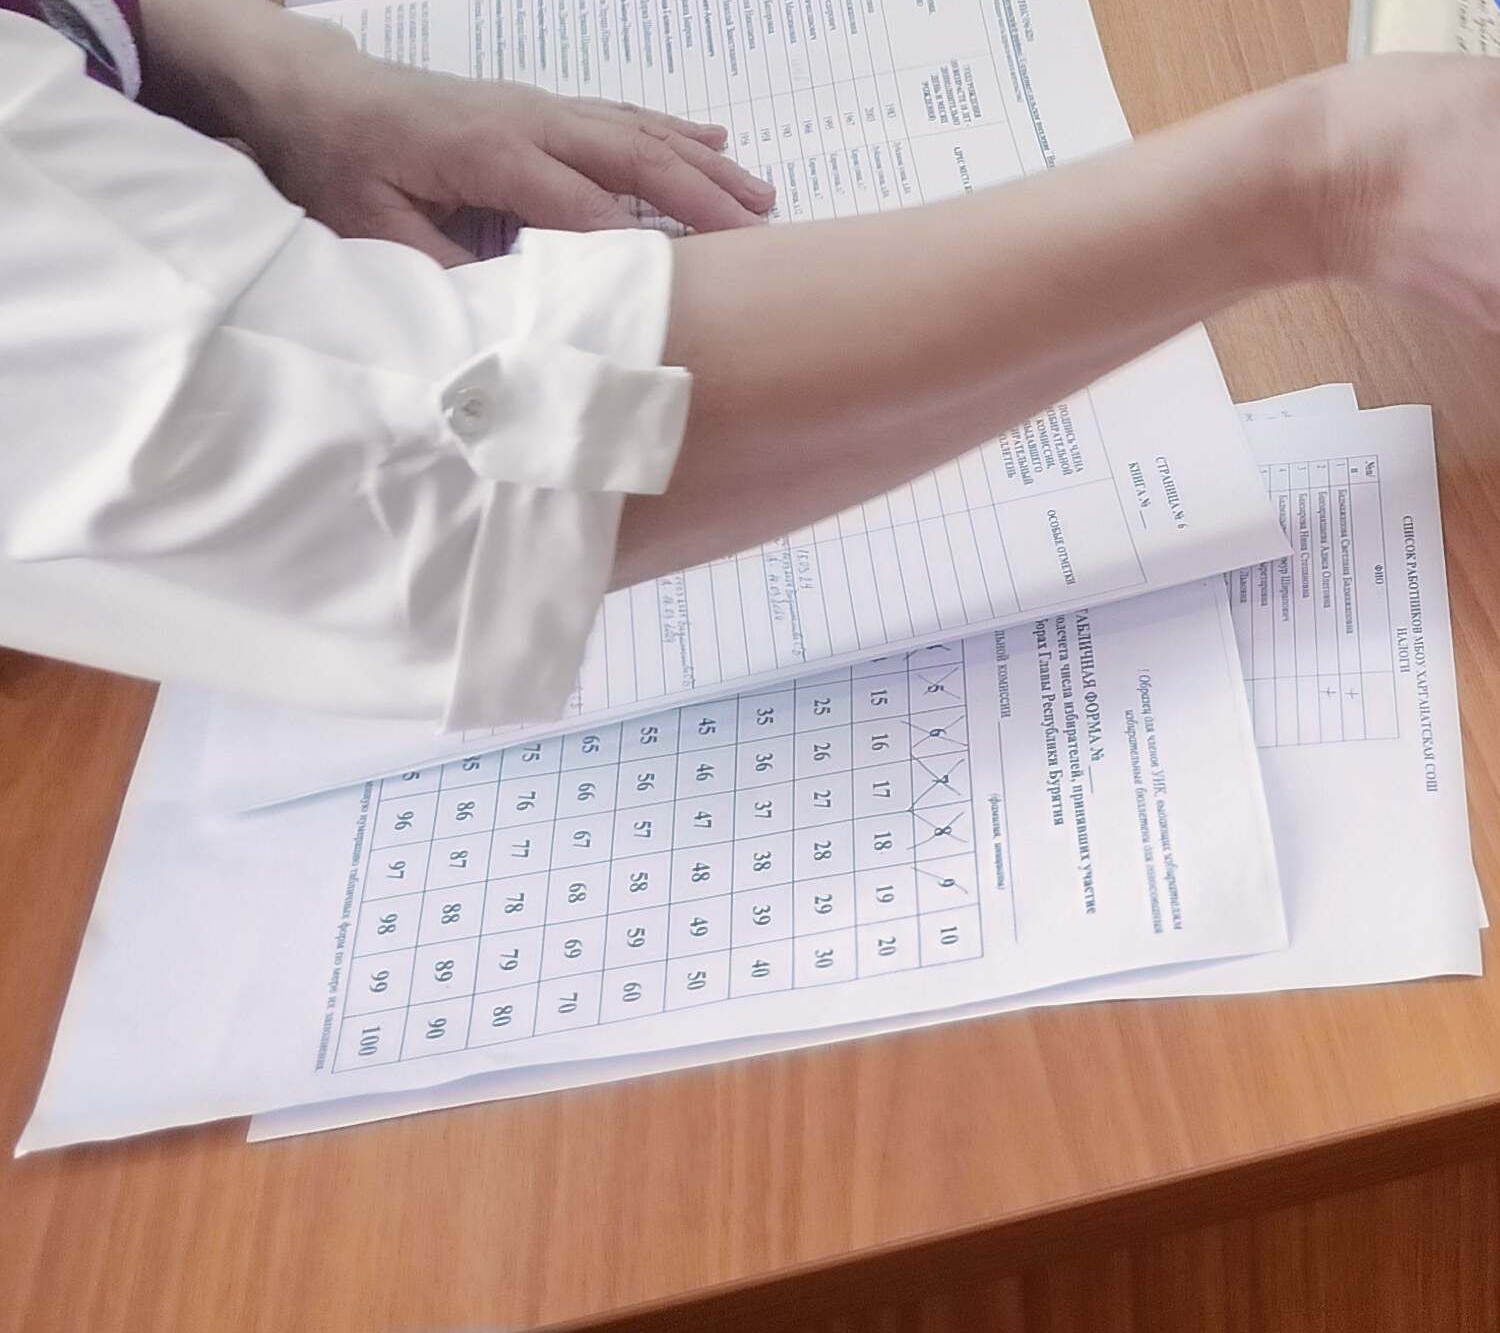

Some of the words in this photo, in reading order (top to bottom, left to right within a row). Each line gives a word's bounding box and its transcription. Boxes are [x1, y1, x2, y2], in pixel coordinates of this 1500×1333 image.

[1068, 445, 1083, 472] ЧЛЕНА
[1127, 462, 1146, 496] КНИГА
[1155, 457, 1179, 509] СТРАНИЦА
[1046, 510, 1062, 546] ОСОБЫЕ
[1054, 547, 1074, 585] ОТМЕТКИ
[1402, 516, 1415, 561] СПИСОК
[1299, 553, 1311, 598] Степановна
[1372, 565, 1383, 584] ФИО
[1405, 562, 1422, 634] РАБОТНИКОВ
[1395, 628, 1409, 673] НАЛОГИ
[1411, 636, 1425, 668] МБОУ
[1036, 652, 1053, 691] Главы
[1059, 663, 1074, 699] числа
[870, 690, 886, 705] 15
[996, 665, 1010, 718] комиссии
[813, 698, 829, 715] 25
[1414, 671, 1433, 760] ХАРГАНАТСКАЯ
[698, 718, 714, 734] 45
[756, 708, 773, 725] 35
[1081, 691, 1101, 744] ФОРМА
[640, 727, 657, 744] 55
[927, 728, 945, 737] 6
[1040, 693, 1059, 766] Республики
[581, 736, 599, 753] 65
[871, 734, 888, 750] 16
[1062, 701, 1082, 782] избирателей,
[1123, 710, 1145, 785] избирательные
[521, 743, 540, 762] 75
[813, 743, 830, 761] 26
[1089, 748, 1103, 762] №
[755, 754, 772, 771] 36
[636, 773, 653, 791] 56
[695, 764, 712, 781] 46
[1423, 763, 1436, 792] СОШ
[577, 783, 594, 800] 66
[813, 790, 830, 807] 27
[872, 781, 889, 797] 17
[1046, 769, 1066, 826] Бурятия
[516, 792, 535, 810] 76
[754, 801, 771, 818] 37
[455, 802, 474, 820] 86
[693, 812, 710, 828] 47
[1133, 787, 1152, 843] бюллетени
[394, 812, 413, 830] 96
[633, 821, 650, 837] 57
[933, 826, 951, 835] 8
[1071, 784, 1090, 861] принявших
[573, 831, 590, 847] 67
[873, 832, 891, 850] 18
[1146, 735, 1160, 767] членов
[1163, 854, 1184, 930] избирателям
[511, 840, 529, 857] 77
[813, 841, 830, 860] 28
[449, 851, 467, 868] 87
[753, 852, 770, 871] 38
[386, 861, 404, 878] 97
[691, 863, 709, 882] 48
[629, 872, 647, 892] 58
[937, 878, 955, 887] 9
[1078, 865, 1098, 915] участие
[340, 868, 359, 920] табличных
[567, 883, 585, 903] 68
[875, 886, 893, 903] 19
[504, 893, 523, 913] 78
[814, 894, 831, 914] 29
[441, 904, 460, 924] 88
[752, 906, 769, 925] 39
[377, 914, 396, 934] 98
[689, 918, 707, 936] 49
[335, 922, 350, 949] форм
[626, 928, 644, 947] 59
[940, 927, 957, 944] 10
[563, 940, 581, 958] 69
[878, 937, 895, 956] 20
[332, 952, 344, 965] по
[498, 949, 517, 970] 79
[815, 950, 832, 968] 30
[434, 960, 453, 982] 89
[751, 960, 769, 977] 40
[327, 967, 340, 993] мере
[369, 971, 388, 992] 99
[687, 972, 705, 990] 50
[622, 983, 640, 1002] 60
[325, 997, 336, 1009] их
[557, 993, 577, 1013] 70
[491, 1005, 511, 1027] 80
[425, 1018, 445, 1039] 90
[358, 1027, 379, 1056] 100
